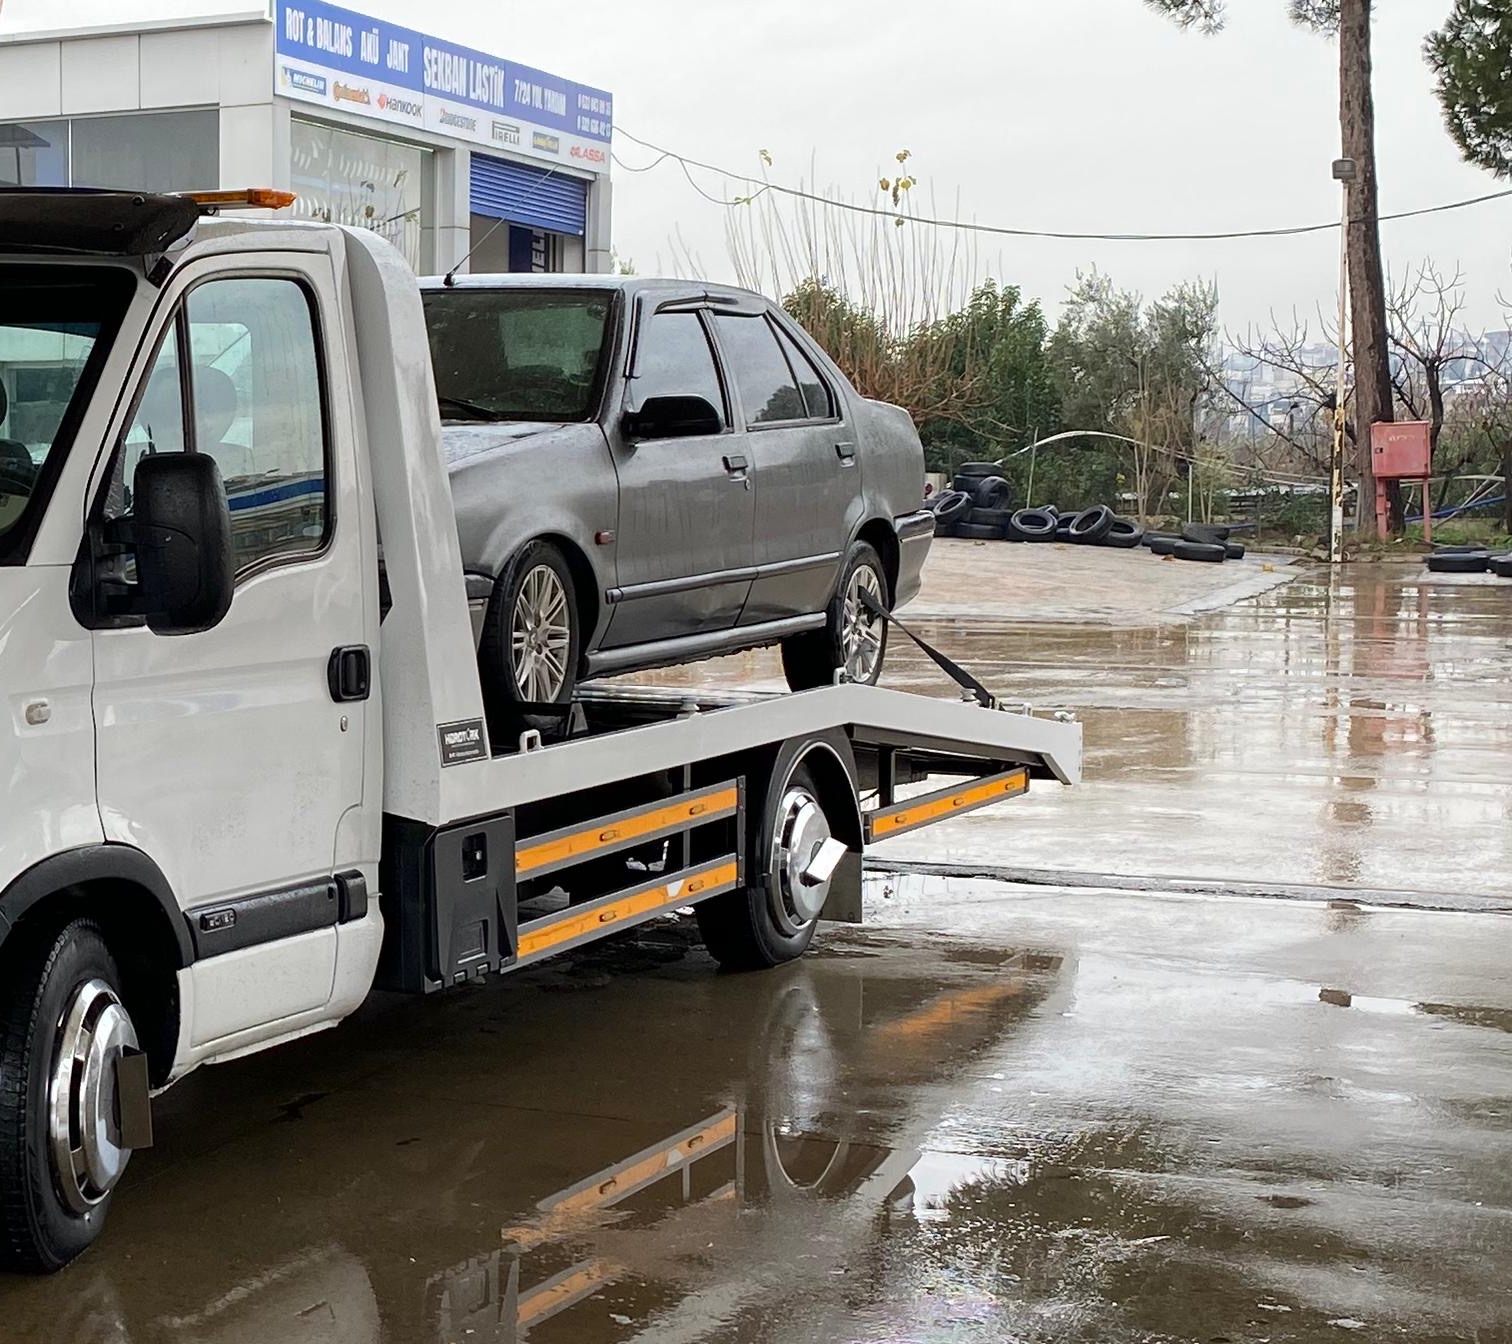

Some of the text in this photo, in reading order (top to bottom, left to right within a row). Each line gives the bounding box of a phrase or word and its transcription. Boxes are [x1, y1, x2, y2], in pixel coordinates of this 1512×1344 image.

[285, 7, 305, 44] ROT
[306, 17, 315, 47] &
[316, 16, 353, 58] BALANS
[360, 27, 380, 65] AKÜ
[386, 39, 410, 73] JANT
[423, 46, 467, 97] SEKBAN
[469, 59, 505, 108] LASTİK
[514, 79, 531, 106] 7/24
[491, 120, 521, 145] PIRELLI
[577, 146, 606, 164] LASSA
